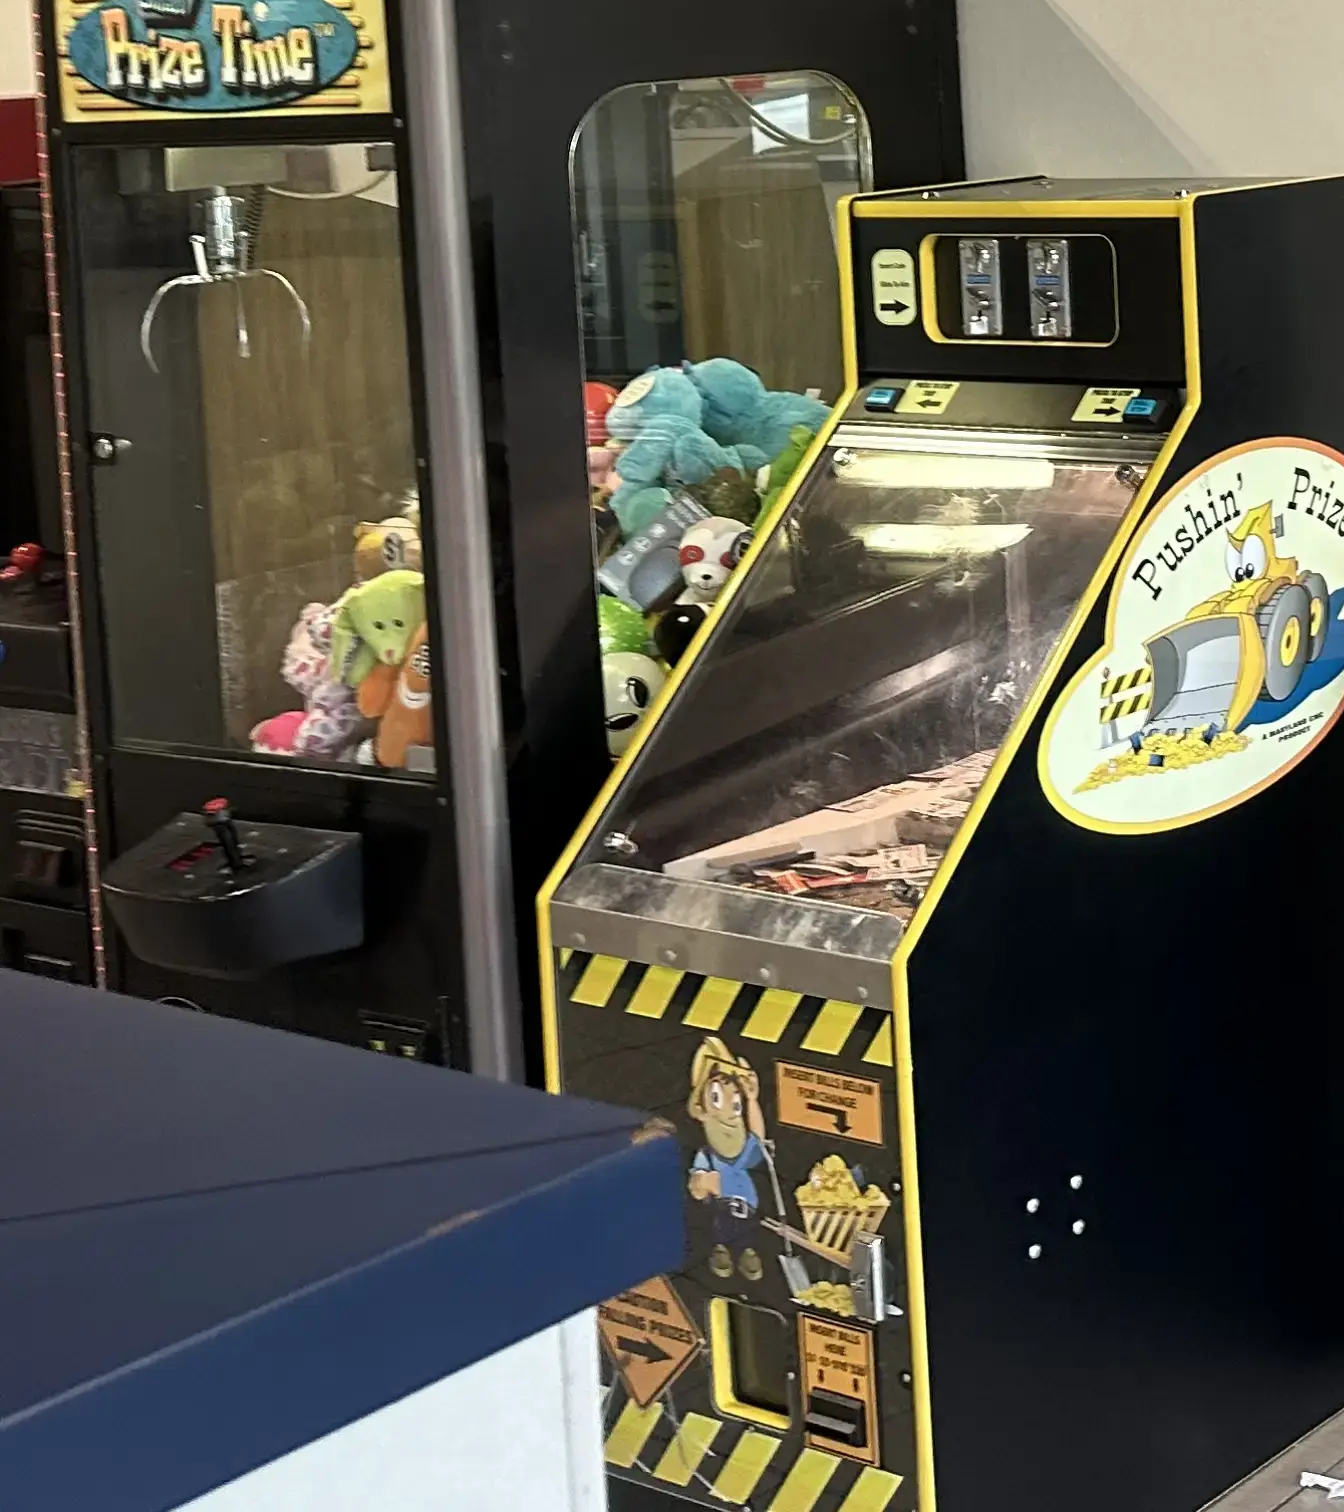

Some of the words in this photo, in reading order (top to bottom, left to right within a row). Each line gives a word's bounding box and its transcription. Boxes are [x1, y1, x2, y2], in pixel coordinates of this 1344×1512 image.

[101, 7, 207, 93] Prize
[210, 3, 317, 89] Time
[1131, 471, 1244, 601] Pushin'
